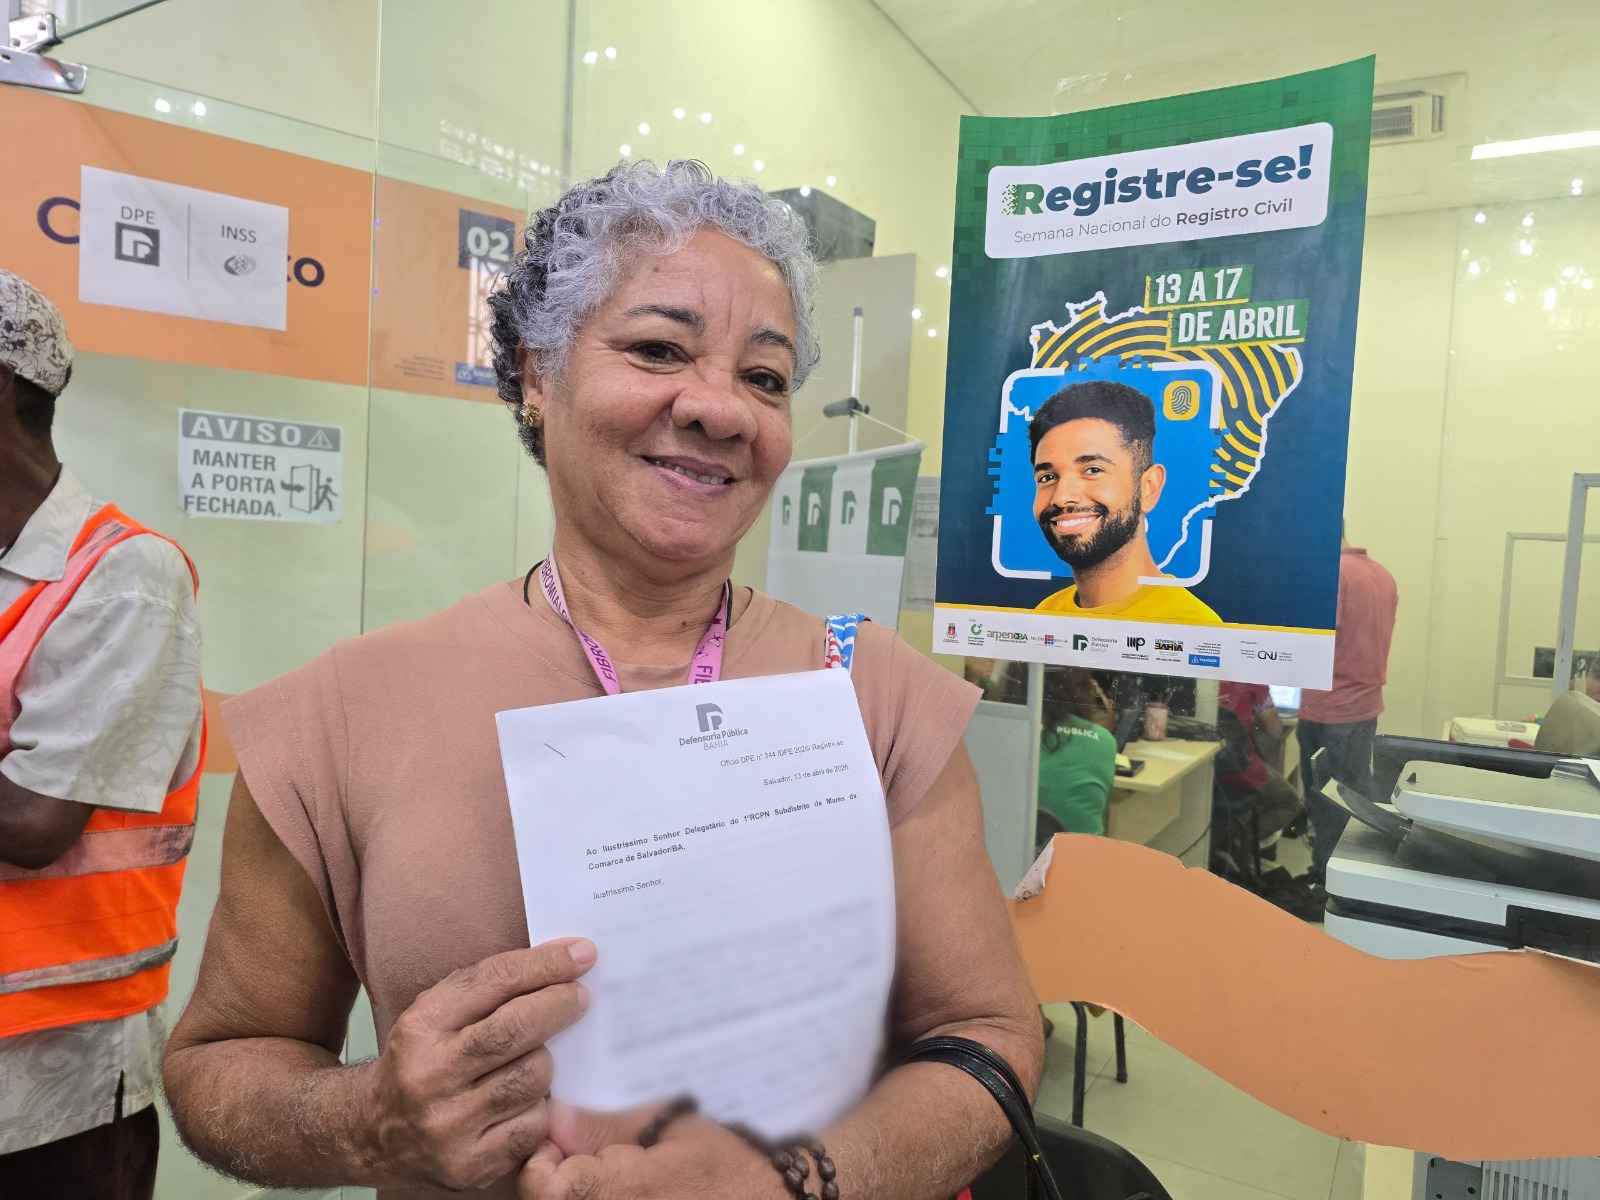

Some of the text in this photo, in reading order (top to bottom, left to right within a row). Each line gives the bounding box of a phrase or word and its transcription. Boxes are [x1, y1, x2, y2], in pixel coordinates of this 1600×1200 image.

[1002, 144, 1314, 217] Registre-se!
[120, 205, 156, 225] DPE
[1014, 198, 1293, 244] Semana Nacional do Registro Civil
[221, 224, 257, 244] INSS
[467, 226, 509, 261] 02
[1155, 268, 1243, 304] 13 A 17
[1178, 304, 1300, 343] DE ABRIL
[191, 415, 302, 447] AVISO
[193, 449, 276, 472] MANTER
[191, 472, 275, 495] A PORTA
[183, 494, 282, 518] FECHADA.
[679, 728, 749, 746] Defensoria Pública
[703, 739, 729, 751] BAHIA
[740, 755, 756, 764] DPE
[763, 775, 793, 786] Salvador,
[793, 772, 803, 780] 13
[812, 768, 825, 777] abril
[586, 848, 597, 856] Ao
[653, 831, 680, 842] Senhor
[685, 820, 726, 834] Delegatário
[774, 802, 810, 816] Subdistrito
[826, 796, 845, 805] Mares
[849, 792, 857, 800] da
[588, 857, 624, 870] Comarca
